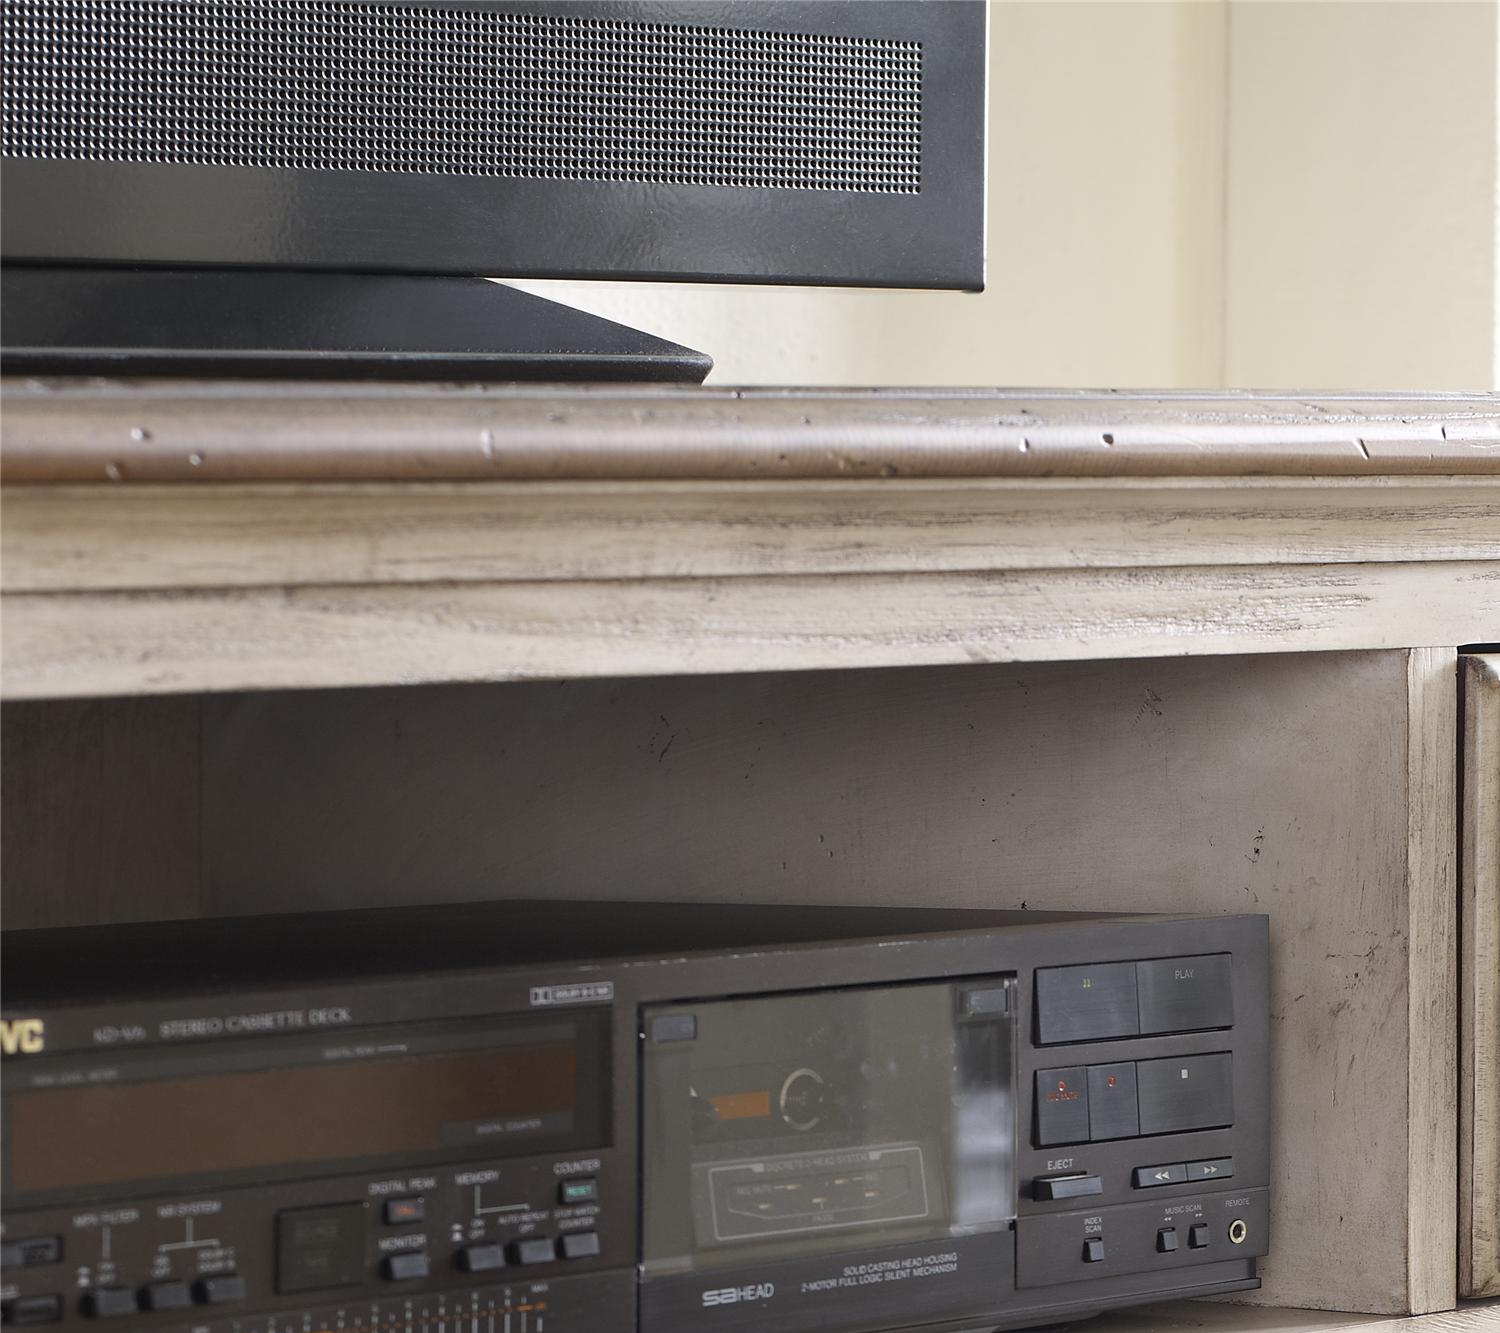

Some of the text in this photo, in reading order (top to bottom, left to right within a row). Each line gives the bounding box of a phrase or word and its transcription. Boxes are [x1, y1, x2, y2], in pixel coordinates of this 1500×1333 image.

[1175, 969, 1194, 980] PLAY
[159, 1007, 352, 1039] STEREO CASSETTE DECK
[553, 1159, 601, 1174] COUNTER
[1047, 1158, 1075, 1171] EJECT
[455, 1170, 499, 1185] MEMORY
[368, 1180, 406, 1195] DIGITAL
[1165, 1204, 1202, 1215] MUSIC SCAN
[1225, 1198, 1250, 1208] REMOTE
[1084, 1217, 1103, 1226] INDEX
[1084, 1225, 1102, 1234] SCAN
[378, 1234, 427, 1250] MONITOR
[843, 1252, 958, 1277] SOLID CASTING HEAD HOUSING
[838, 1275, 858, 1288] FULL
[859, 1272, 883, 1285] LOGIC
[884, 1267, 911, 1281] SILENT
[912, 1262, 958, 1278] MECHANISM
